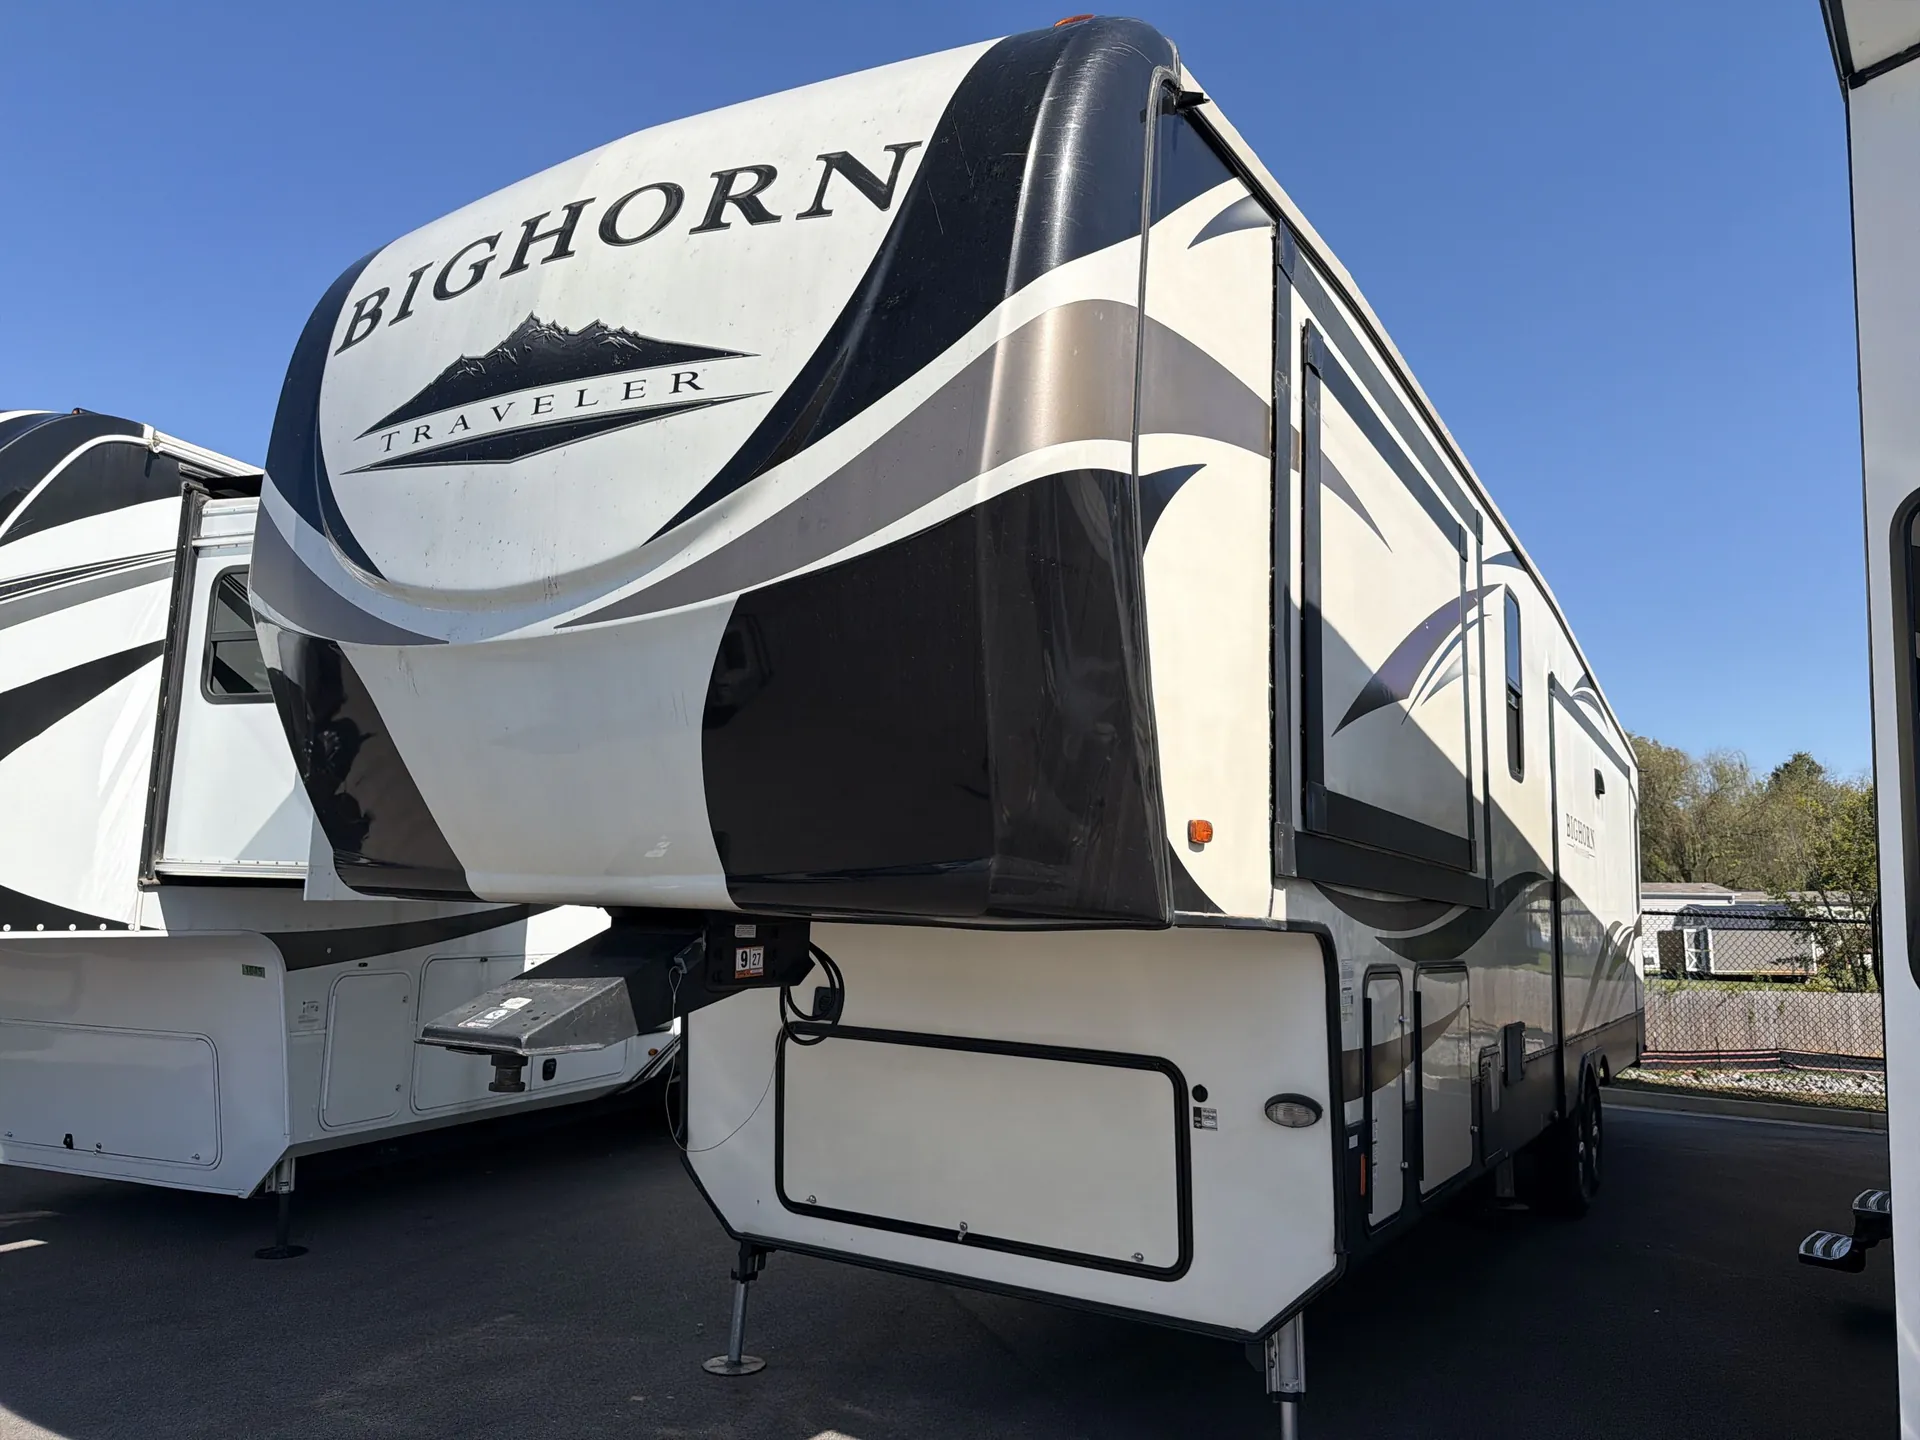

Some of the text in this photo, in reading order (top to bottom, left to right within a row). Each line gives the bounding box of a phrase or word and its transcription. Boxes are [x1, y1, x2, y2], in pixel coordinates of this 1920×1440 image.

[334, 141, 923, 356] BIGHORN
[380, 370, 706, 453] TRAVELER
[1566, 813, 1595, 849] BIGHORN
[741, 950, 761, 968] 9 27
